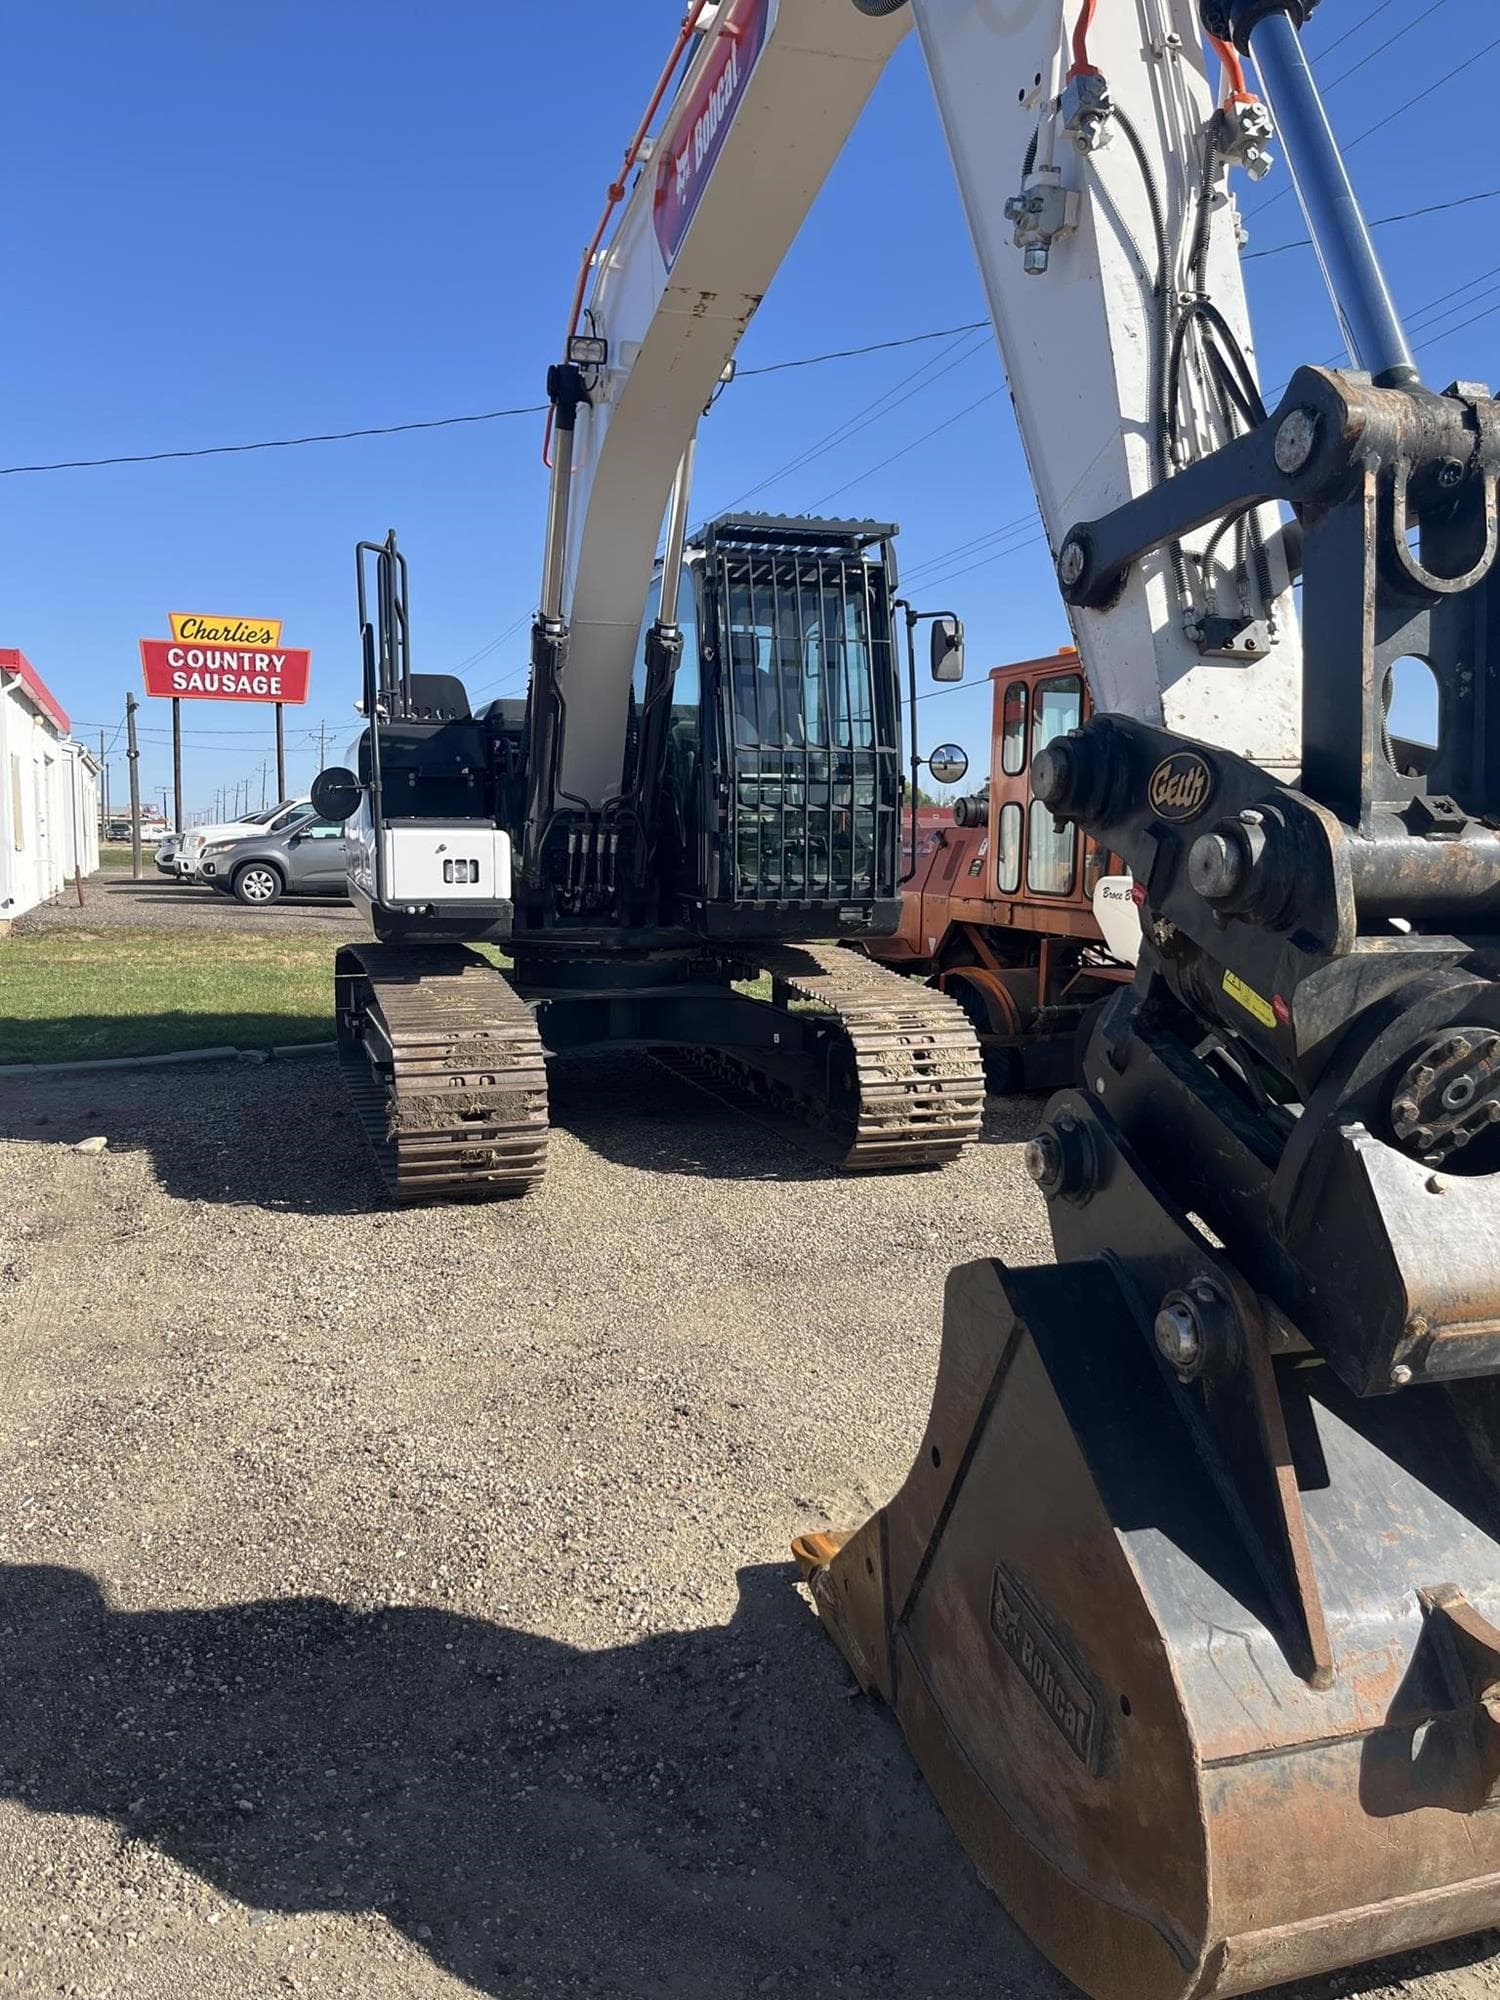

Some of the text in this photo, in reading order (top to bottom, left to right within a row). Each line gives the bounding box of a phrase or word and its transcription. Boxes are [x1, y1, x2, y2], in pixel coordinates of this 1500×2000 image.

[694, 39, 738, 173] Bobcat
[180, 618, 273, 644] Charlie's
[167, 648, 286, 673] COUNTRY
[172, 672, 282, 695] SAUSAGE
[1022, 1631, 1085, 1750] Bobcat
